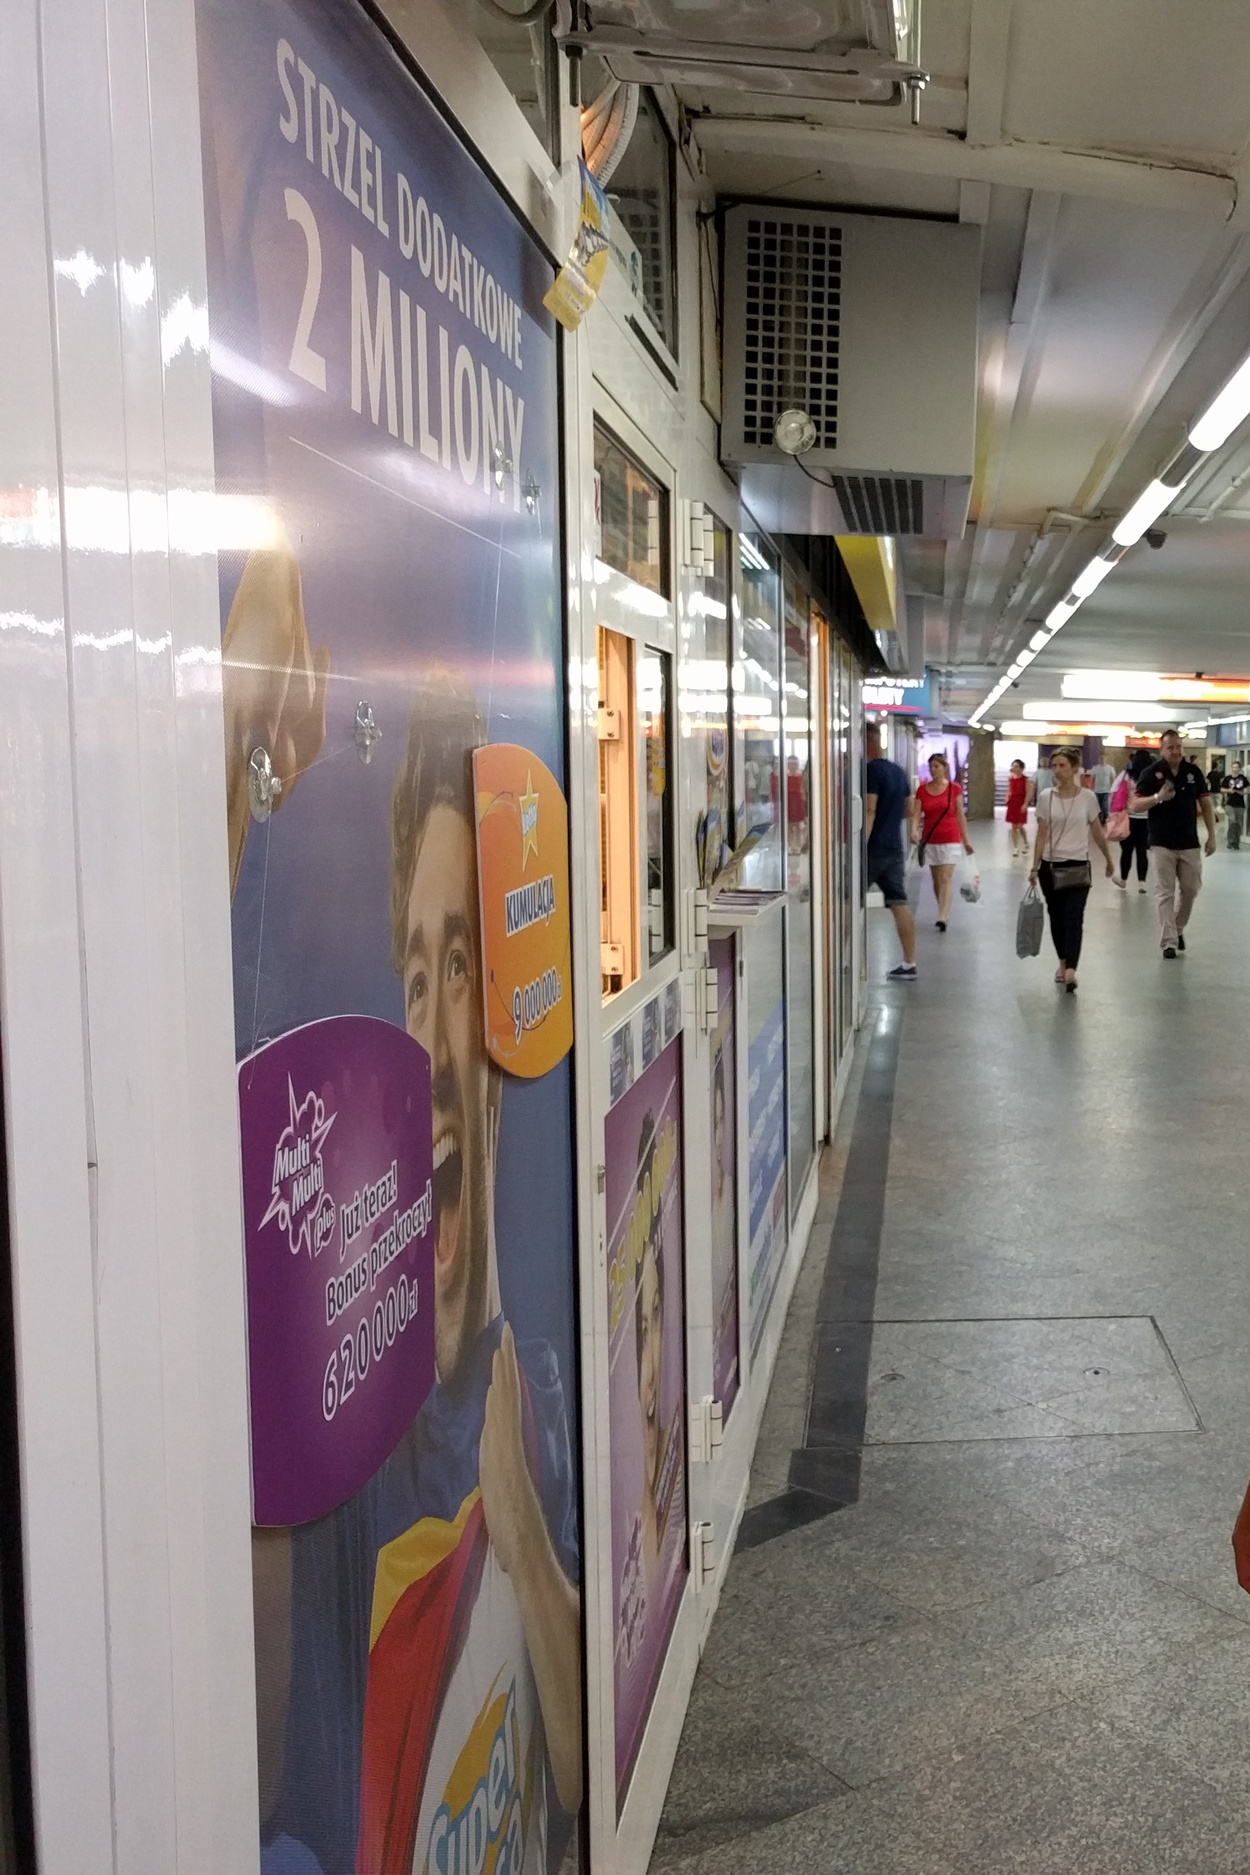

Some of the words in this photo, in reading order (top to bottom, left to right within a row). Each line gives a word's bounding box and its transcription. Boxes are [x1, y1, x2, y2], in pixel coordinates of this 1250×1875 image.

[276, 38, 389, 239] STRZEL
[397, 173, 523, 371] DODATKOWE
[284, 187, 327, 392] 2
[350, 243, 525, 514] MILIONY
[505, 875, 556, 937] KUMULACJA
[275, 1133, 311, 1185] Multi
[292, 1160, 322, 1217] Multi
[316, 1205, 335, 1252] plus
[340, 1190, 362, 1263] Już
[363, 1159, 398, 1227] teraz!
[326, 1252, 367, 1326] Bonus
